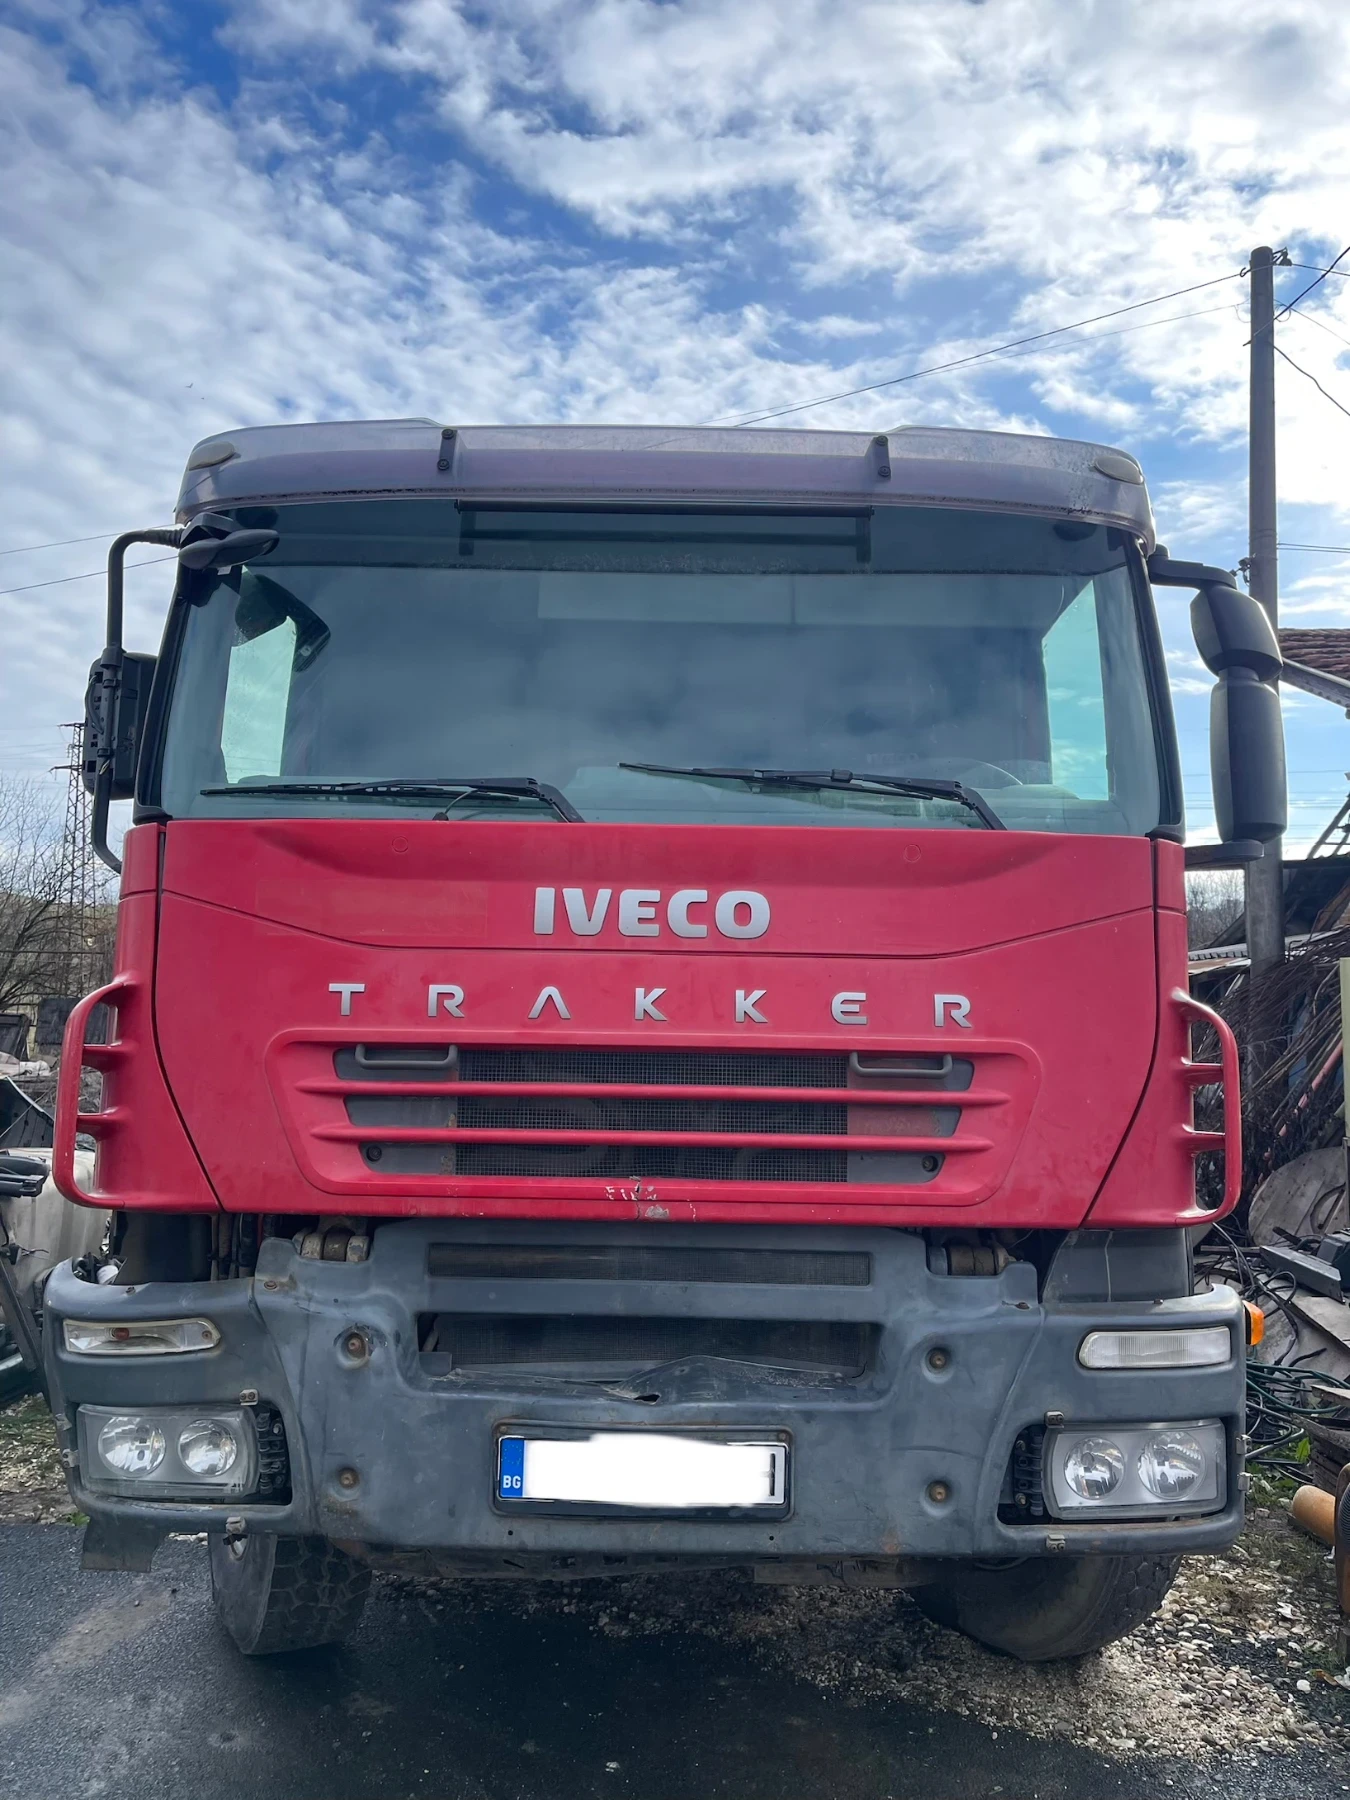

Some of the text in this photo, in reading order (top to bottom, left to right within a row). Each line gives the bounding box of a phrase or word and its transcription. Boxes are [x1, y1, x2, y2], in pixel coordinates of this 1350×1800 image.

[533, 886, 771, 939] IVECO
[328, 982, 972, 1029] TRAKKER
[502, 1475, 522, 1490] BG
